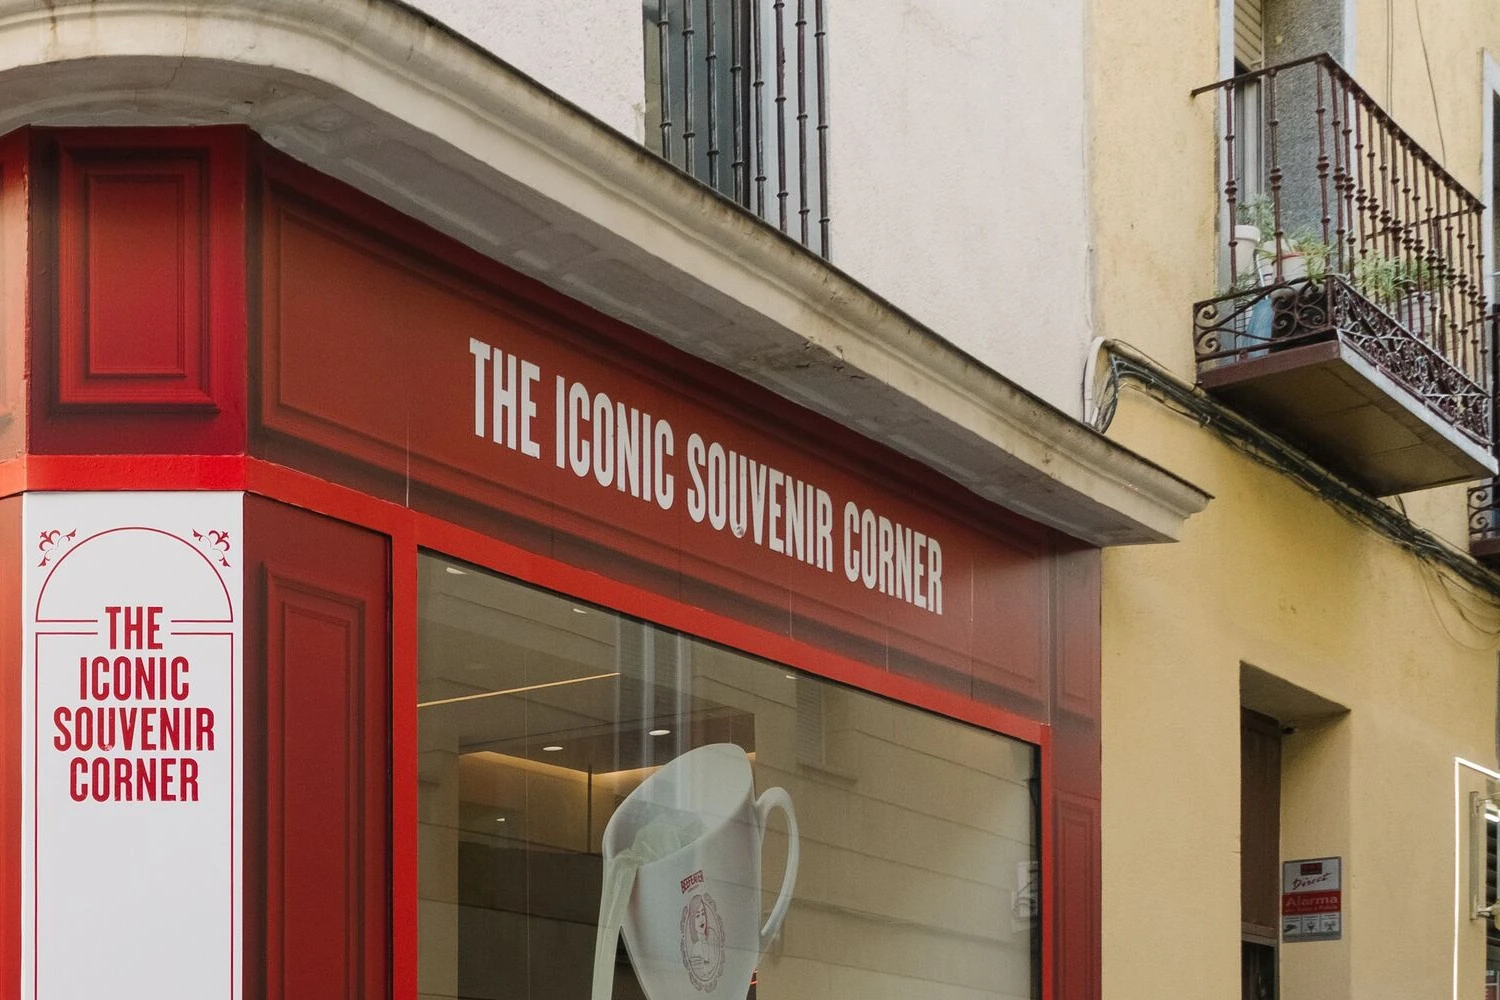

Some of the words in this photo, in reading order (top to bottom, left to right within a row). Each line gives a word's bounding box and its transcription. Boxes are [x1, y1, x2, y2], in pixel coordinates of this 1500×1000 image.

[469, 336, 541, 460] THE
[555, 374, 675, 510] ICONIC
[686, 433, 834, 573] SOUVENIR
[843, 501, 943, 616] CORNER
[104, 606, 164, 650] THE
[79, 655, 190, 701] ICONIC
[53, 706, 215, 752] SOUVENIR
[70, 756, 199, 802] CORNER
[1285, 895, 1339, 907] Alarma
